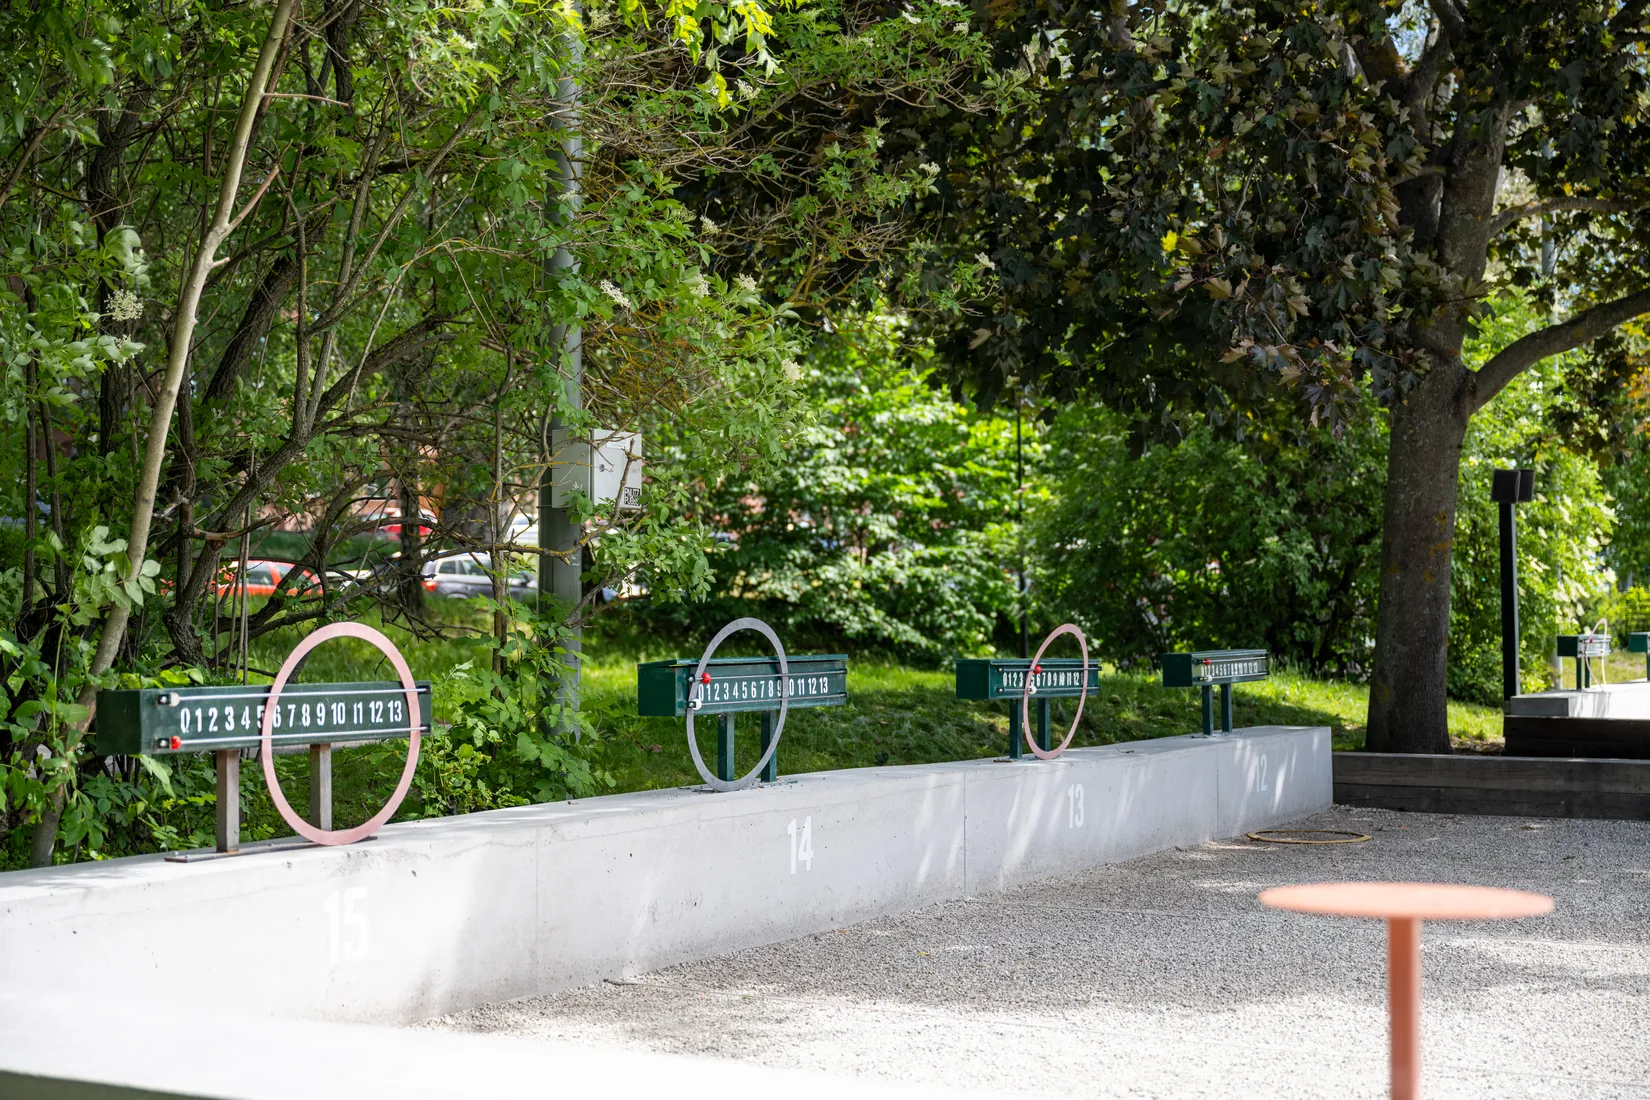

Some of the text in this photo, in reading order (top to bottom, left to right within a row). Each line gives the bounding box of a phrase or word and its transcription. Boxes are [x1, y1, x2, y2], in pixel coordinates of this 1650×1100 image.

[698, 683, 704, 701] 0
[706, 684, 711, 701] 1
[714, 683, 720, 701] 2
[723, 682, 729, 700] 3
[732, 682, 739, 699] 4
[742, 681, 748, 699] 5
[751, 681, 757, 698] 6
[760, 680, 765, 698] 7
[768, 680, 774, 697] 8
[777, 680, 782, 697] 9
[797, 678, 805, 695] 11
[808, 677, 817, 695] 12
[819, 676, 828, 694] 13
[1008, 672, 1012, 687] 1
[1013, 672, 1017, 687] 2
[1019, 672, 1024, 687] 3
[1042, 672, 1046, 686] 7
[1048, 672, 1052, 686] 8
[1053, 672, 1058, 686] 9
[1066, 672, 1072, 686] 11
[1074, 672, 1080, 686] 12
[180, 700, 402, 733] 0 1 2 3 4 5 6 7 8 9 10 11 12 13
[1254, 755, 1267, 792] 12
[1068, 784, 1084, 828] 13
[788, 816, 814, 874] 14
[324, 886, 368, 963] 15
